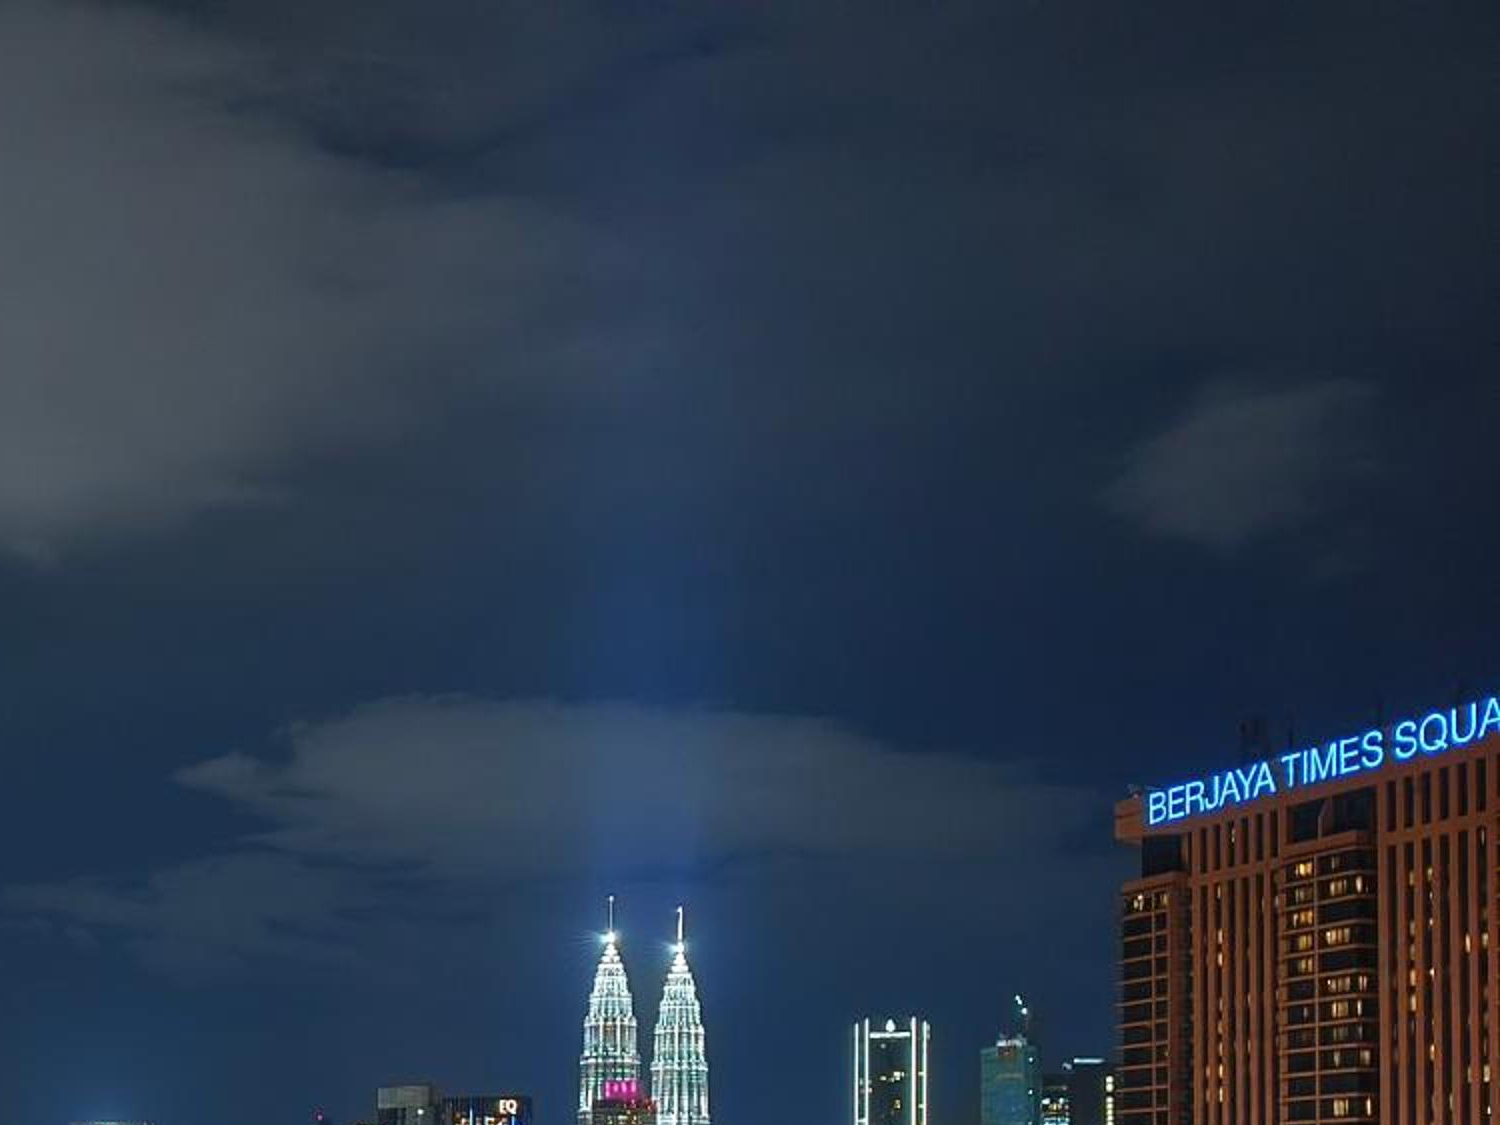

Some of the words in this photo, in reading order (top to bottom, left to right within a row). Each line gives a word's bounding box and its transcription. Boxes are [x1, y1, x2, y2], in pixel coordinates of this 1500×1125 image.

[1148, 762, 1276, 825] BERJAYA
[1281, 729, 1384, 788] TIMES
[499, 1099, 517, 1115] EQ
